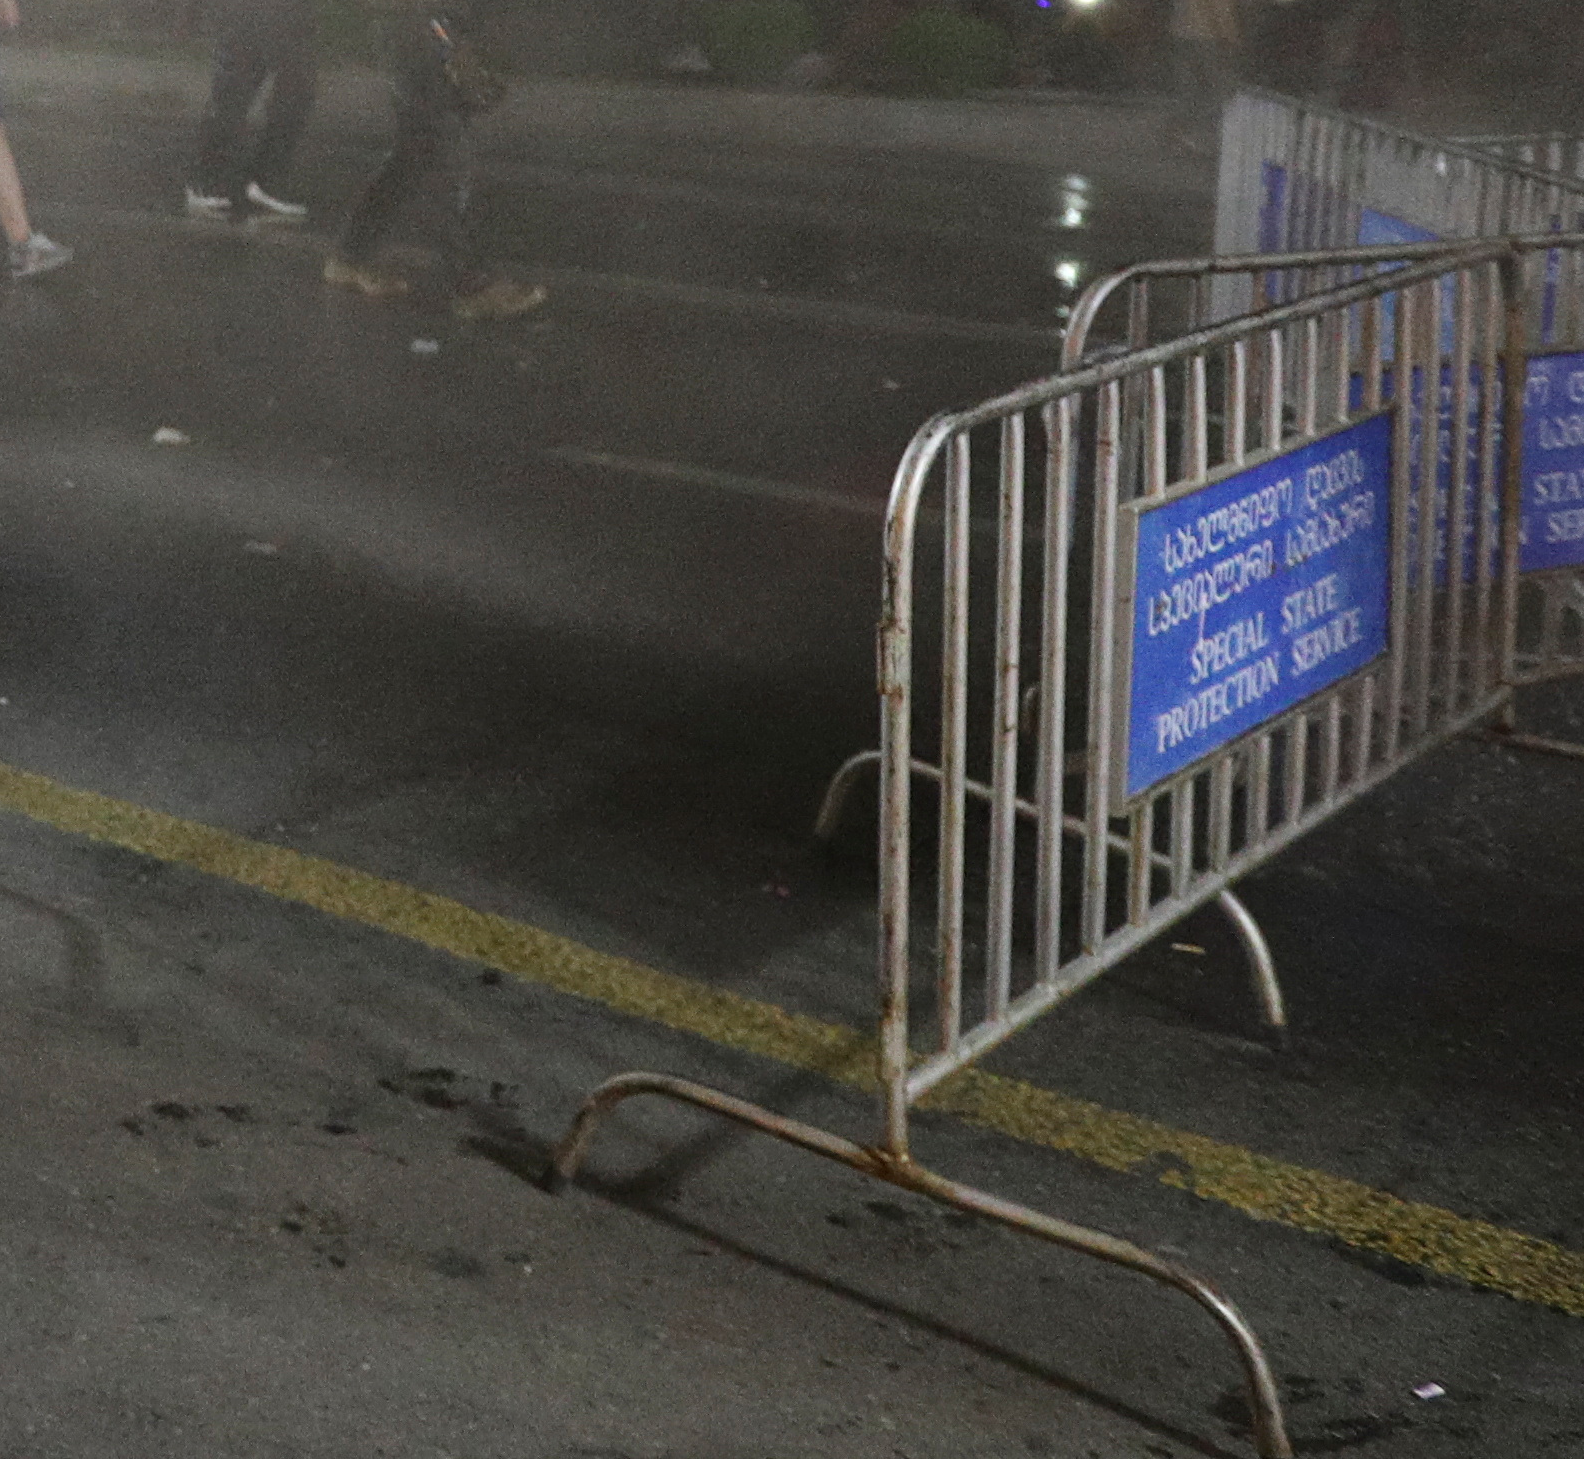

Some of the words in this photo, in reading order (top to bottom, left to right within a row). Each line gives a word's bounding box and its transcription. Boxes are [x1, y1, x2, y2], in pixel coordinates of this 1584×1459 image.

[1155, 652, 1279, 753] PROTECTION
[1291, 609, 1359, 676] SERVICE
[1190, 612, 1268, 684] SPECIAL
[1281, 574, 1337, 634] STATE
